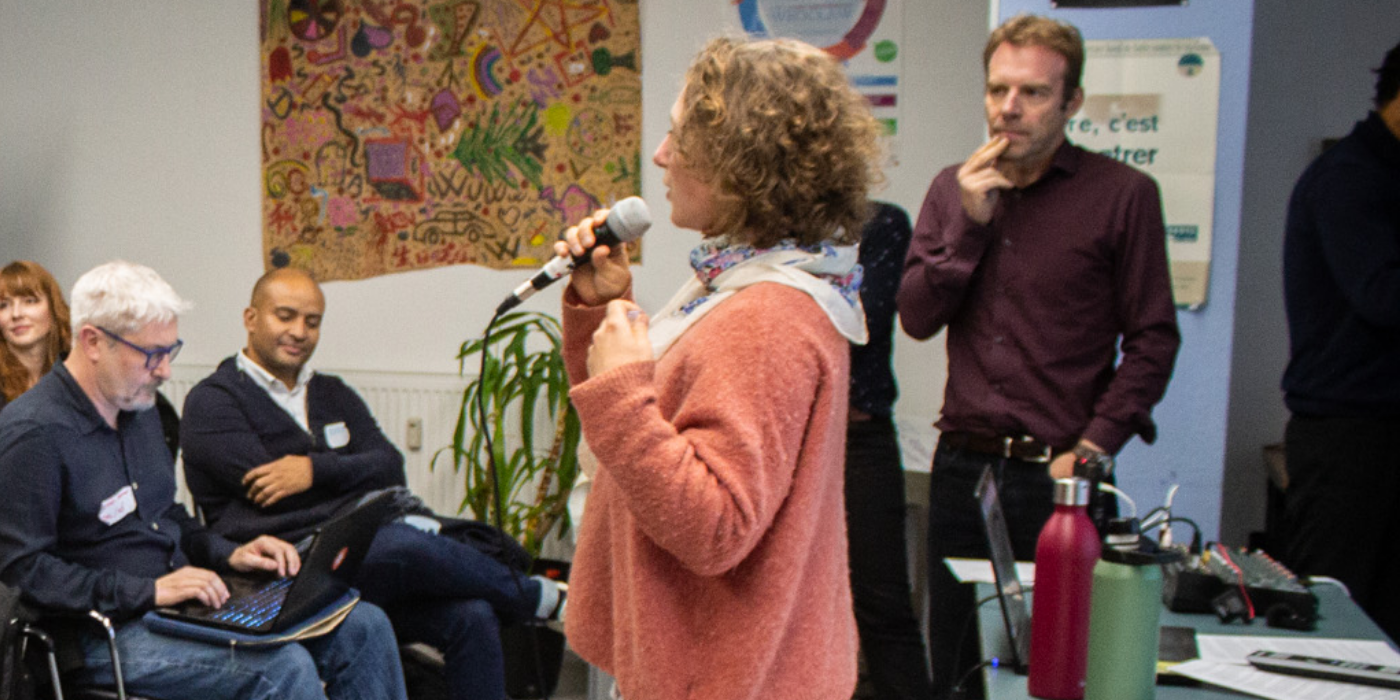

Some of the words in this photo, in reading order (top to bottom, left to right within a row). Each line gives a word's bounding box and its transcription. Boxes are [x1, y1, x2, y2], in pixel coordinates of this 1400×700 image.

[1068, 117, 1099, 136] re,
[1109, 112, 1159, 132] c'est
[1111, 144, 1158, 166] trer
